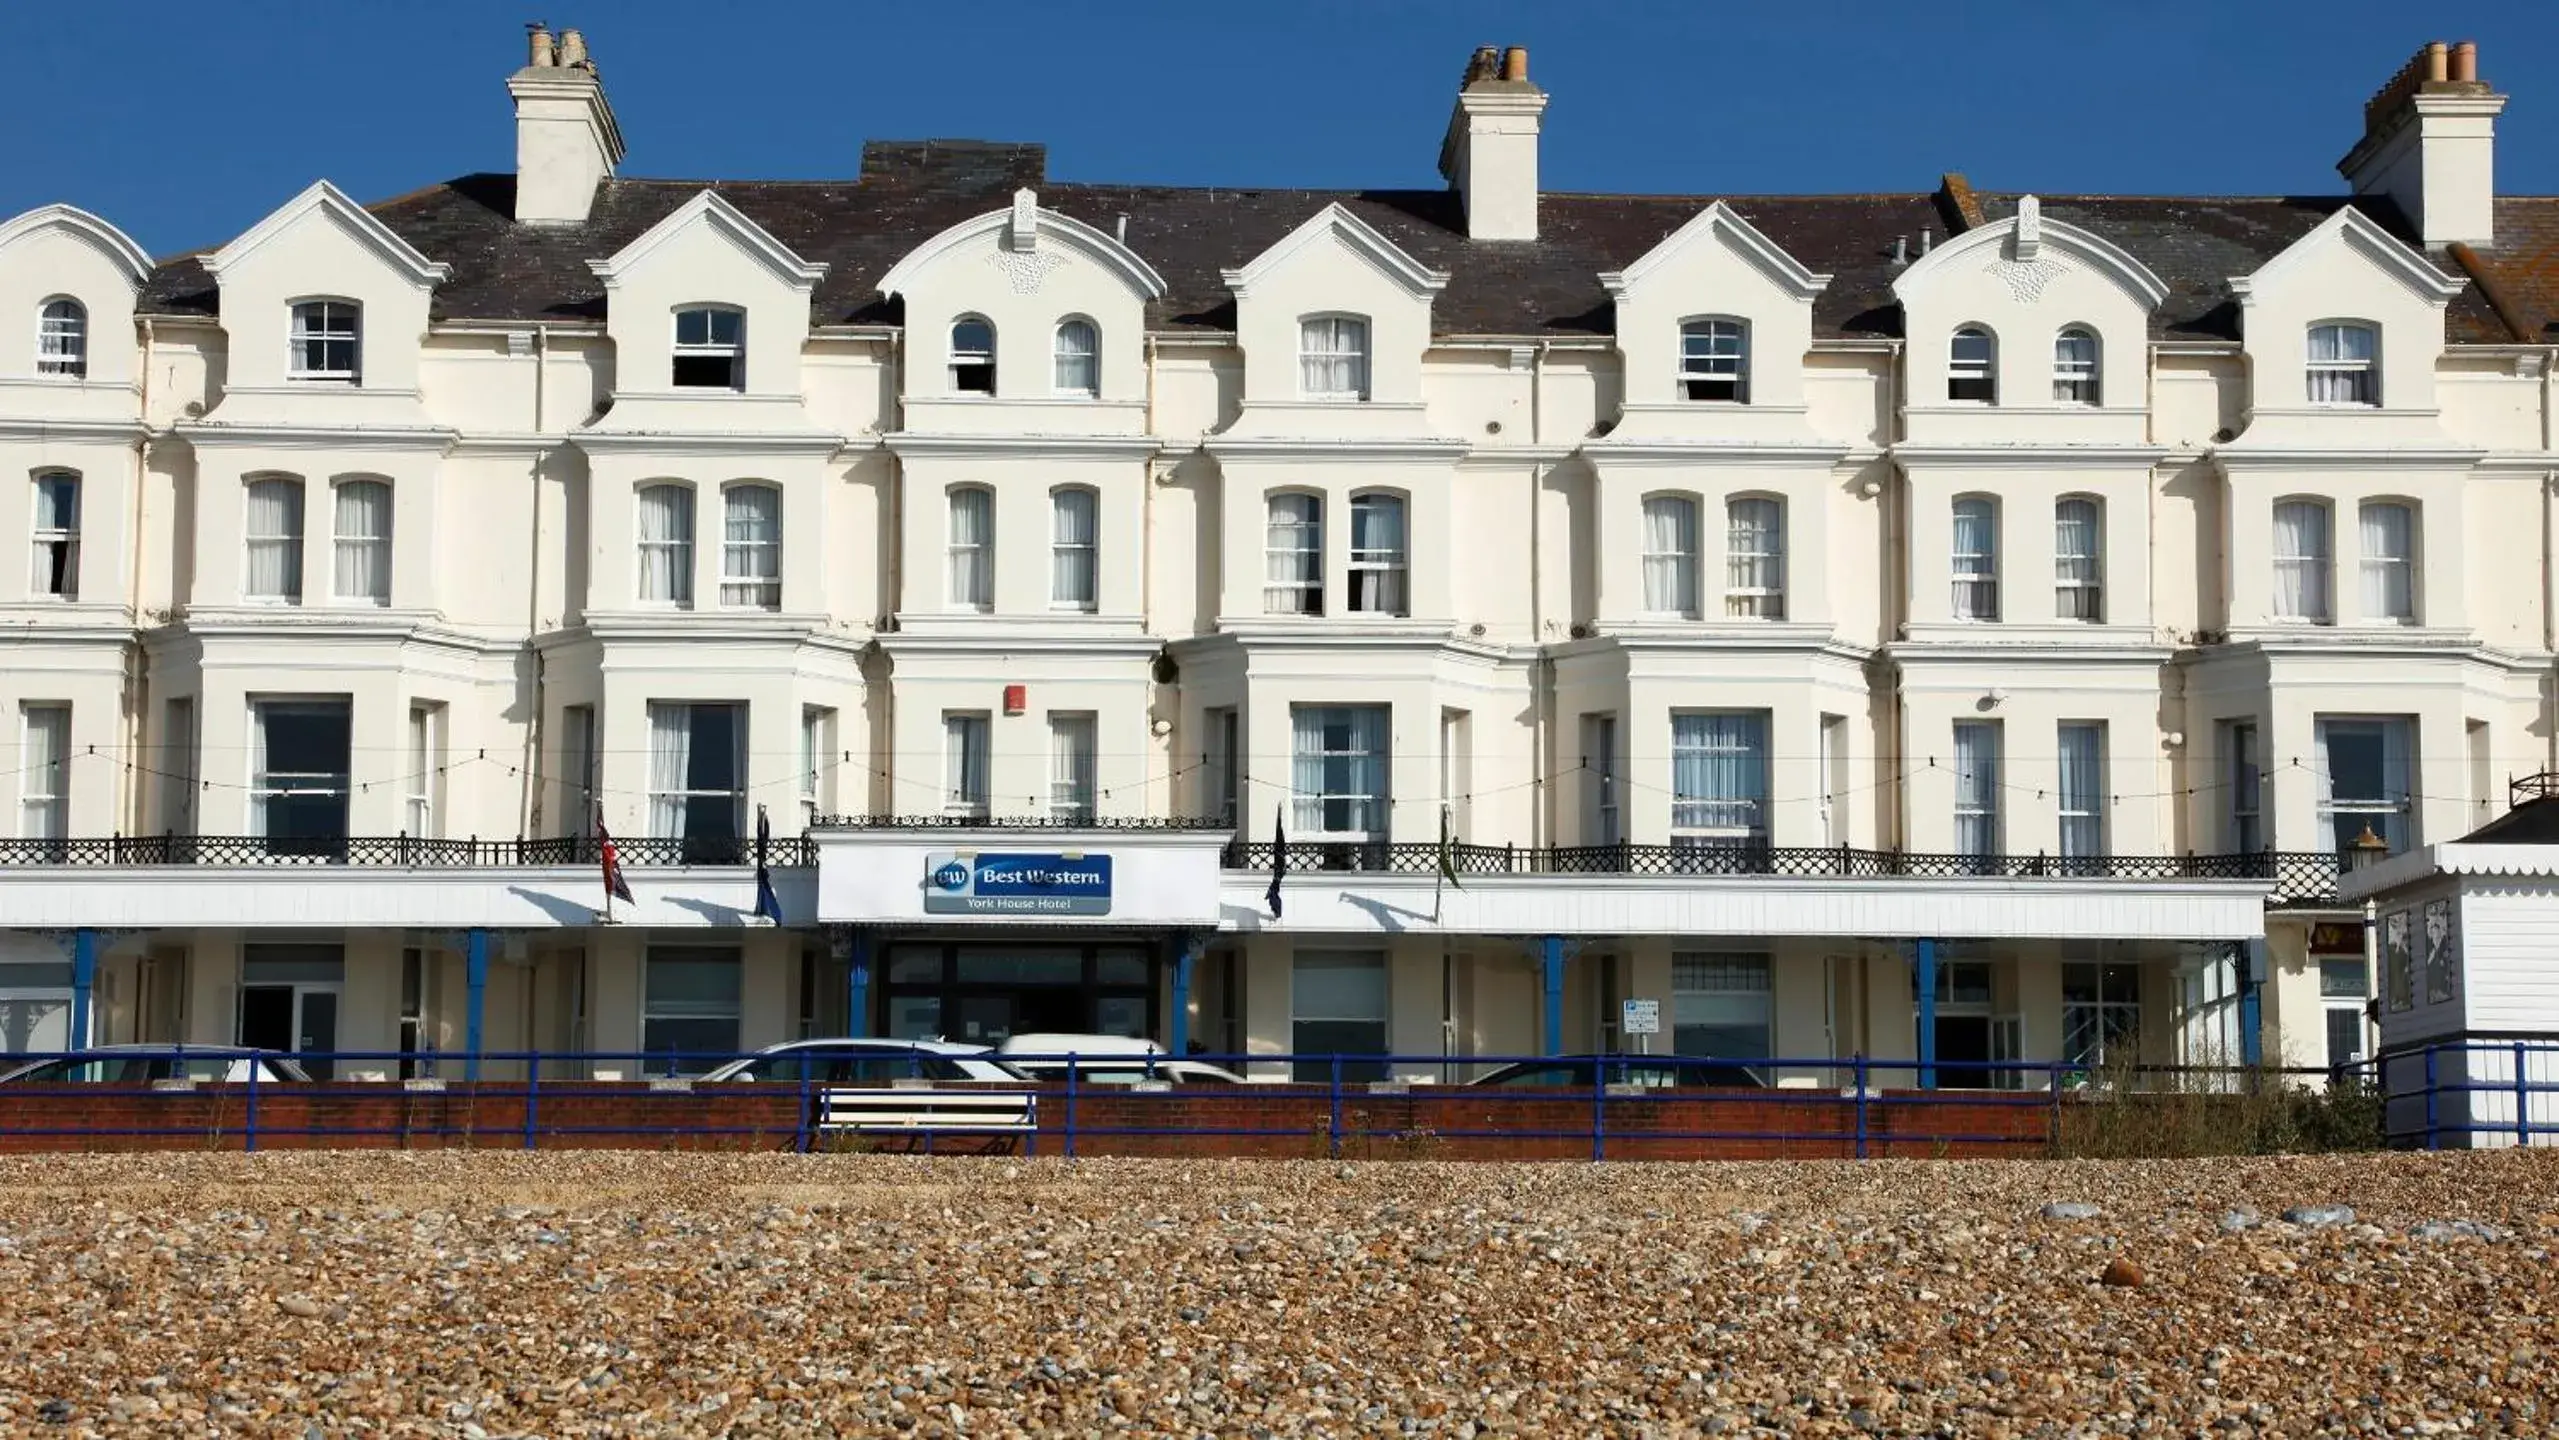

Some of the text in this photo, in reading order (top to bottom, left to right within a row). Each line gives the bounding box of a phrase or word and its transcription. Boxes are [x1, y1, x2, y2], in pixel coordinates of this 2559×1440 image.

[983, 869, 1023, 884] Best
[968, 899, 1071, 909] York House Hotel
